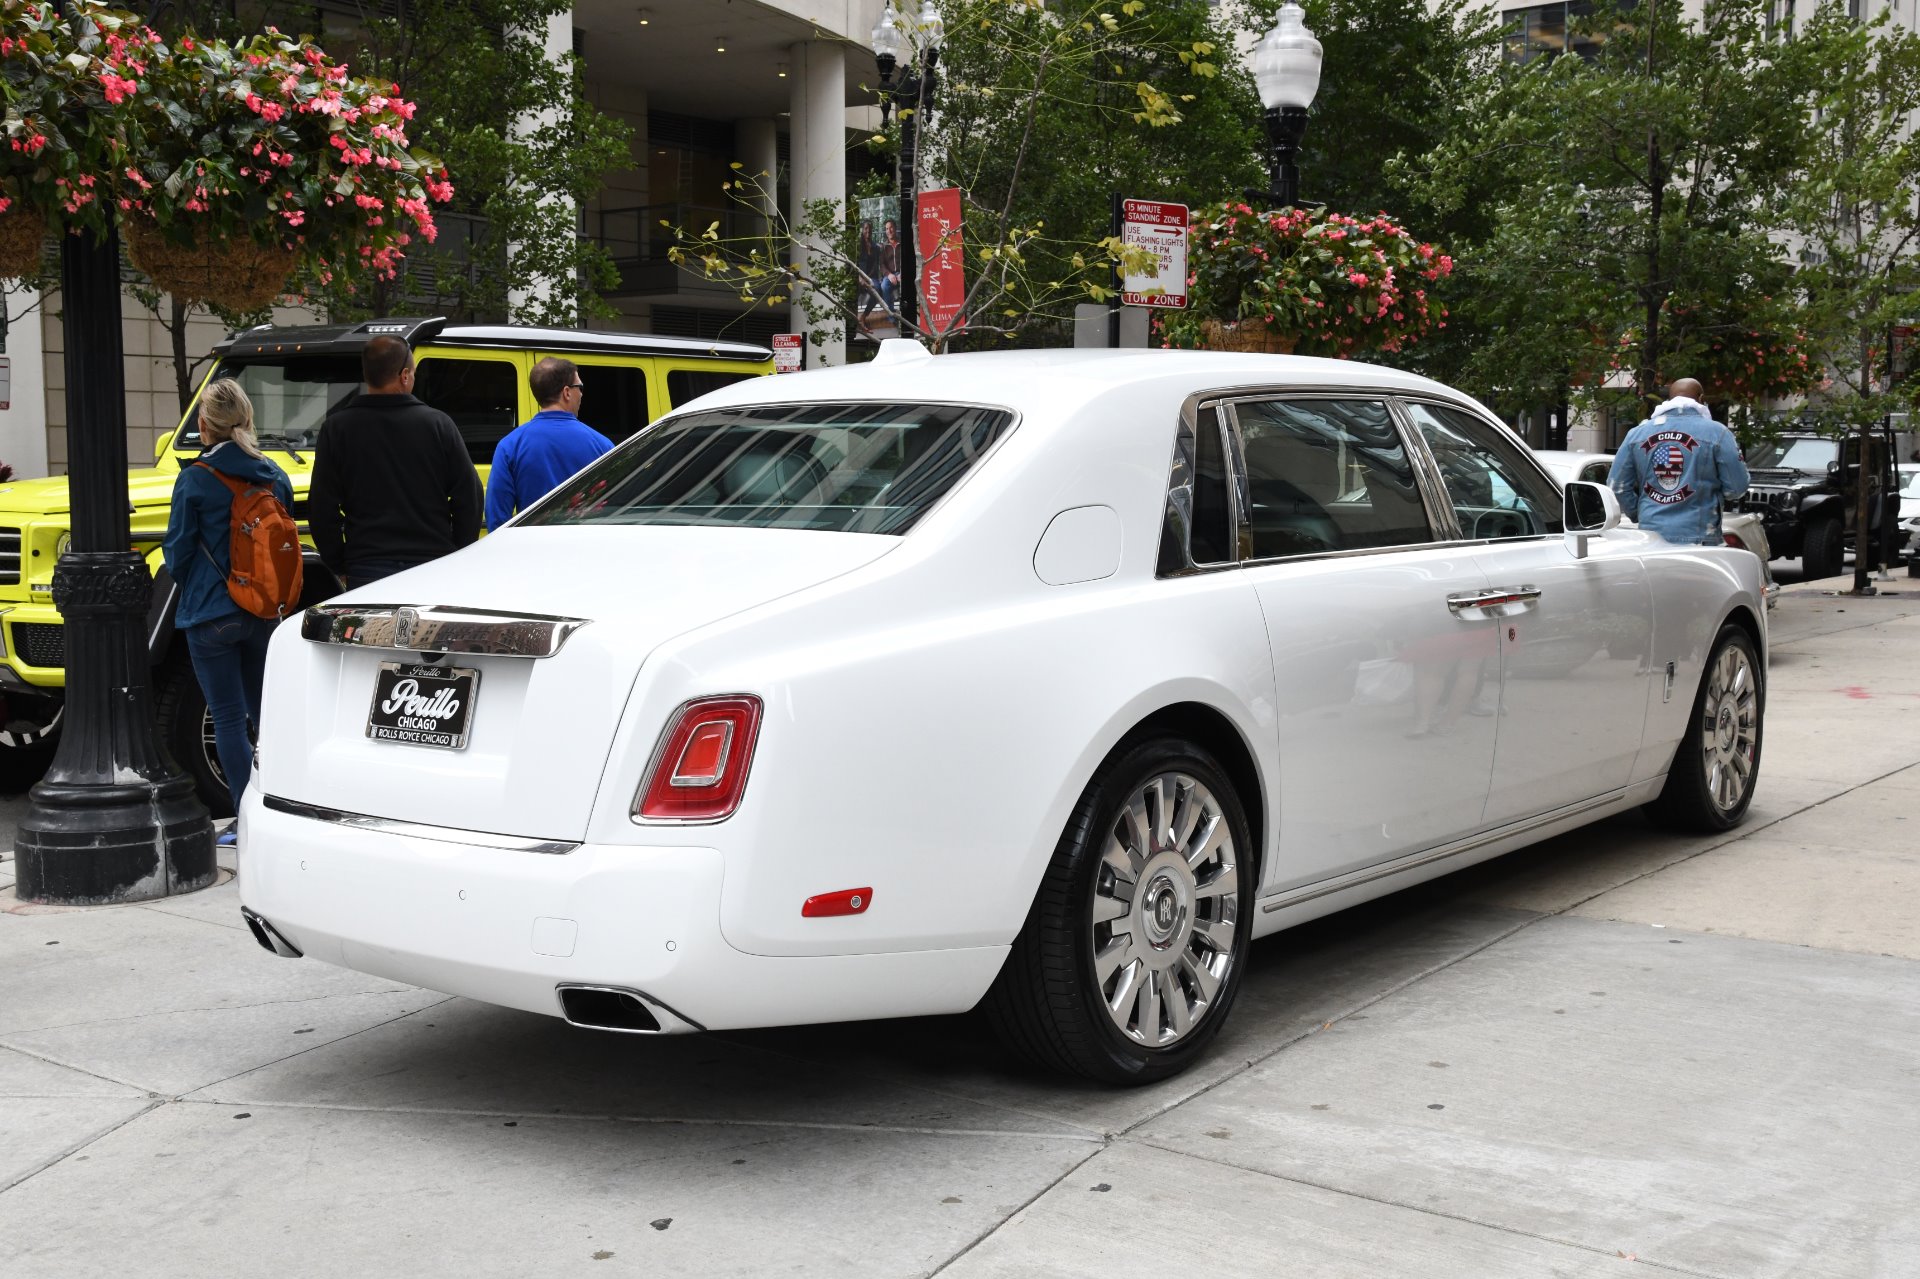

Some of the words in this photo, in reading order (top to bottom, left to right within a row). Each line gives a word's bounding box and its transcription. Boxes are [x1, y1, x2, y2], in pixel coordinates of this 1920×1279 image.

[1128, 203, 1135, 212] 15
[1137, 204, 1162, 214] MINUTE
[1128, 212, 1160, 223] STANDING
[1163, 215, 1181, 225] ZONE
[1127, 226, 1141, 235] USE
[940, 218, 953, 271] Foed
[1127, 235, 1160, 245] FLASHING
[1161, 239, 1184, 248] LIGHTS
[1153, 245, 1158, 254] 8
[1159, 246, 1170, 255] PM
[1158, 263, 1169, 272] PM
[927, 270, 941, 304] Map
[1126, 293, 1148, 303] TOW
[1153, 294, 1181, 306] ZONE
[931, 313, 952, 322] LUMA
[1658, 433, 1683, 441] COLD
[1650, 491, 1682, 504] HEARTS
[409, 666, 441, 677] Perillo
[381, 679, 460, 720] Perillo
[397, 716, 437, 731] CHICAGO
[378, 728, 397, 739] ROLLS
[399, 731, 420, 742] ROYCE
[420, 733, 450, 745] CHICAGO
